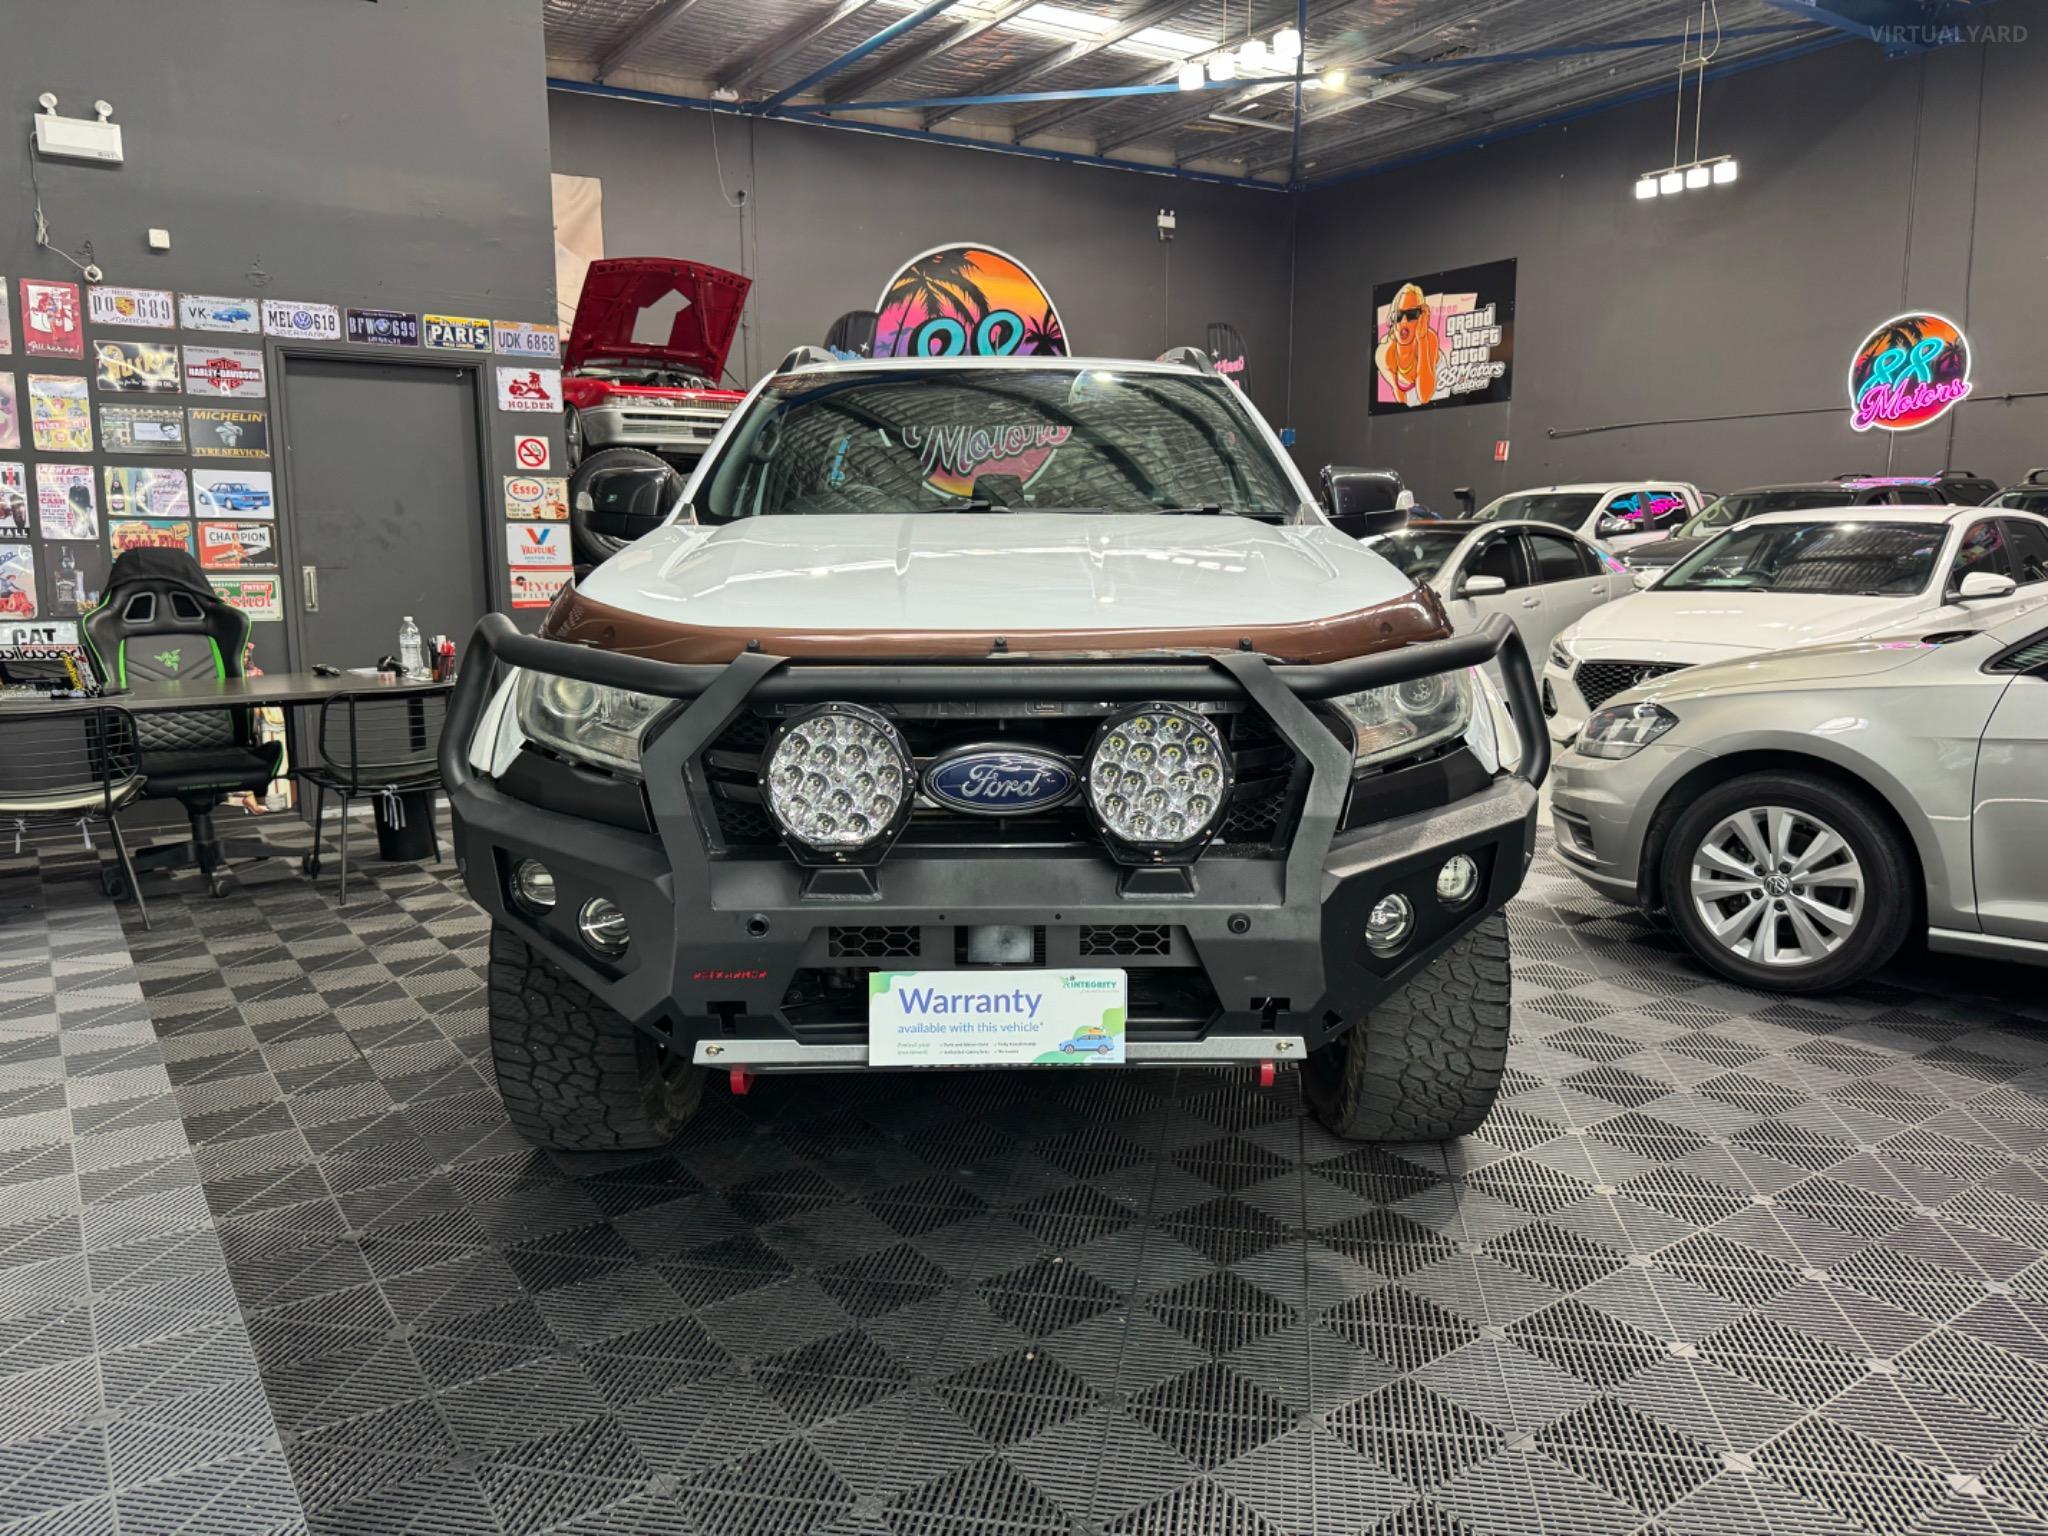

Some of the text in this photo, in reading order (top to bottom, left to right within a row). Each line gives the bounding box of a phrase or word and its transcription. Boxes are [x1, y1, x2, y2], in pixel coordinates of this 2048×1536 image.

[137, 299, 170, 320] 689
[268, 310, 335, 331] MEL 618
[392, 320, 417, 338] 699
[1446, 305, 1496, 336] grand
[431, 325, 486, 344] PARIS
[498, 332, 556, 352] UDK 6868
[1452, 326, 1501, 350] theft
[1450, 347, 1488, 366] auto
[188, 367, 260, 380] HARLEY-DAVIDSON
[1857, 337, 1945, 404] 88
[508, 400, 554, 410] HOLDEN
[1857, 378, 1964, 425] Motors
[192, 410, 262, 422] MICHELIN
[196, 448, 266, 457] TYRE SERVICES
[118, 534, 188, 552] Kodak Film
[520, 545, 557, 556] VALVOLINE
[243, 584, 270, 592] PATENT
[12, 627, 56, 646] CAT
[961, 764, 1042, 798] Ford
[1071, 980, 1117, 989] INTEGRITY
[898, 987, 1042, 1018] Warranty
[897, 1023, 947, 1033] available
[949, 1023, 975, 1033] with
[977, 1022, 998, 1033] this
